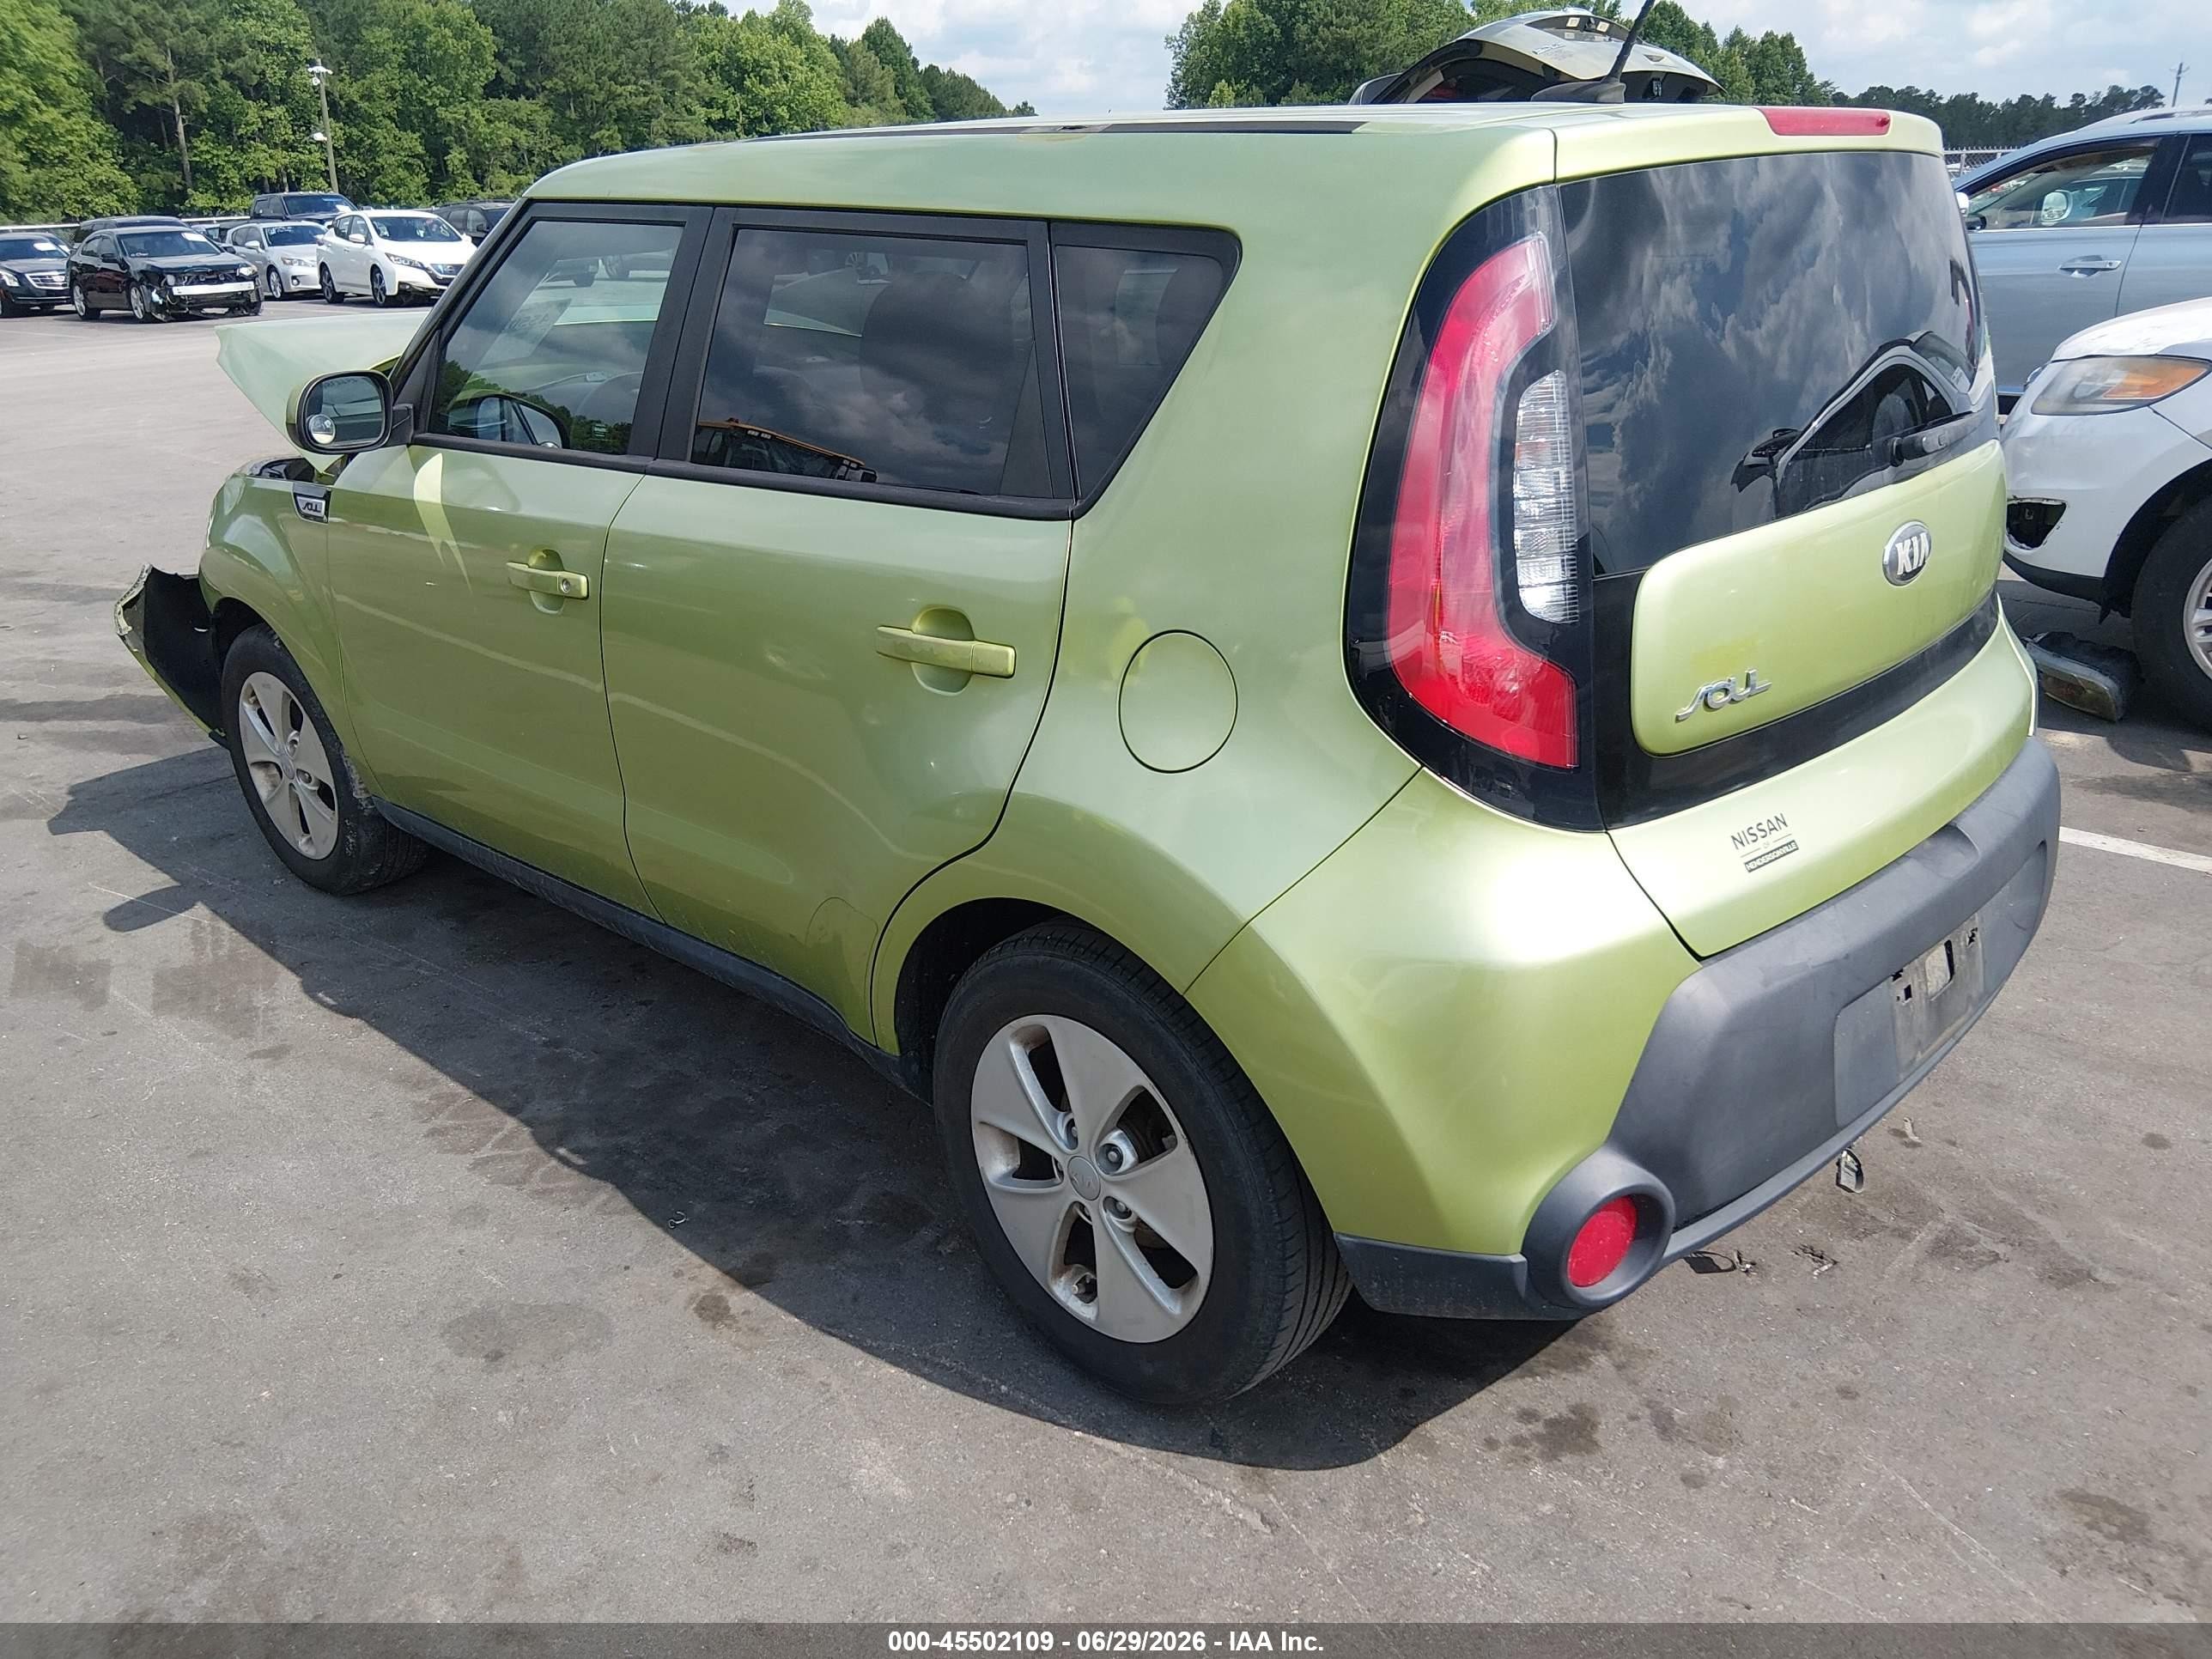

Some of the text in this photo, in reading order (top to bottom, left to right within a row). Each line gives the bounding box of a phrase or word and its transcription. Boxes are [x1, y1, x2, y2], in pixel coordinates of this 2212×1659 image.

[1894, 532, 1929, 575] KIA
[1674, 668, 1772, 723] SOUL
[1730, 812, 1789, 851] NISSAN
